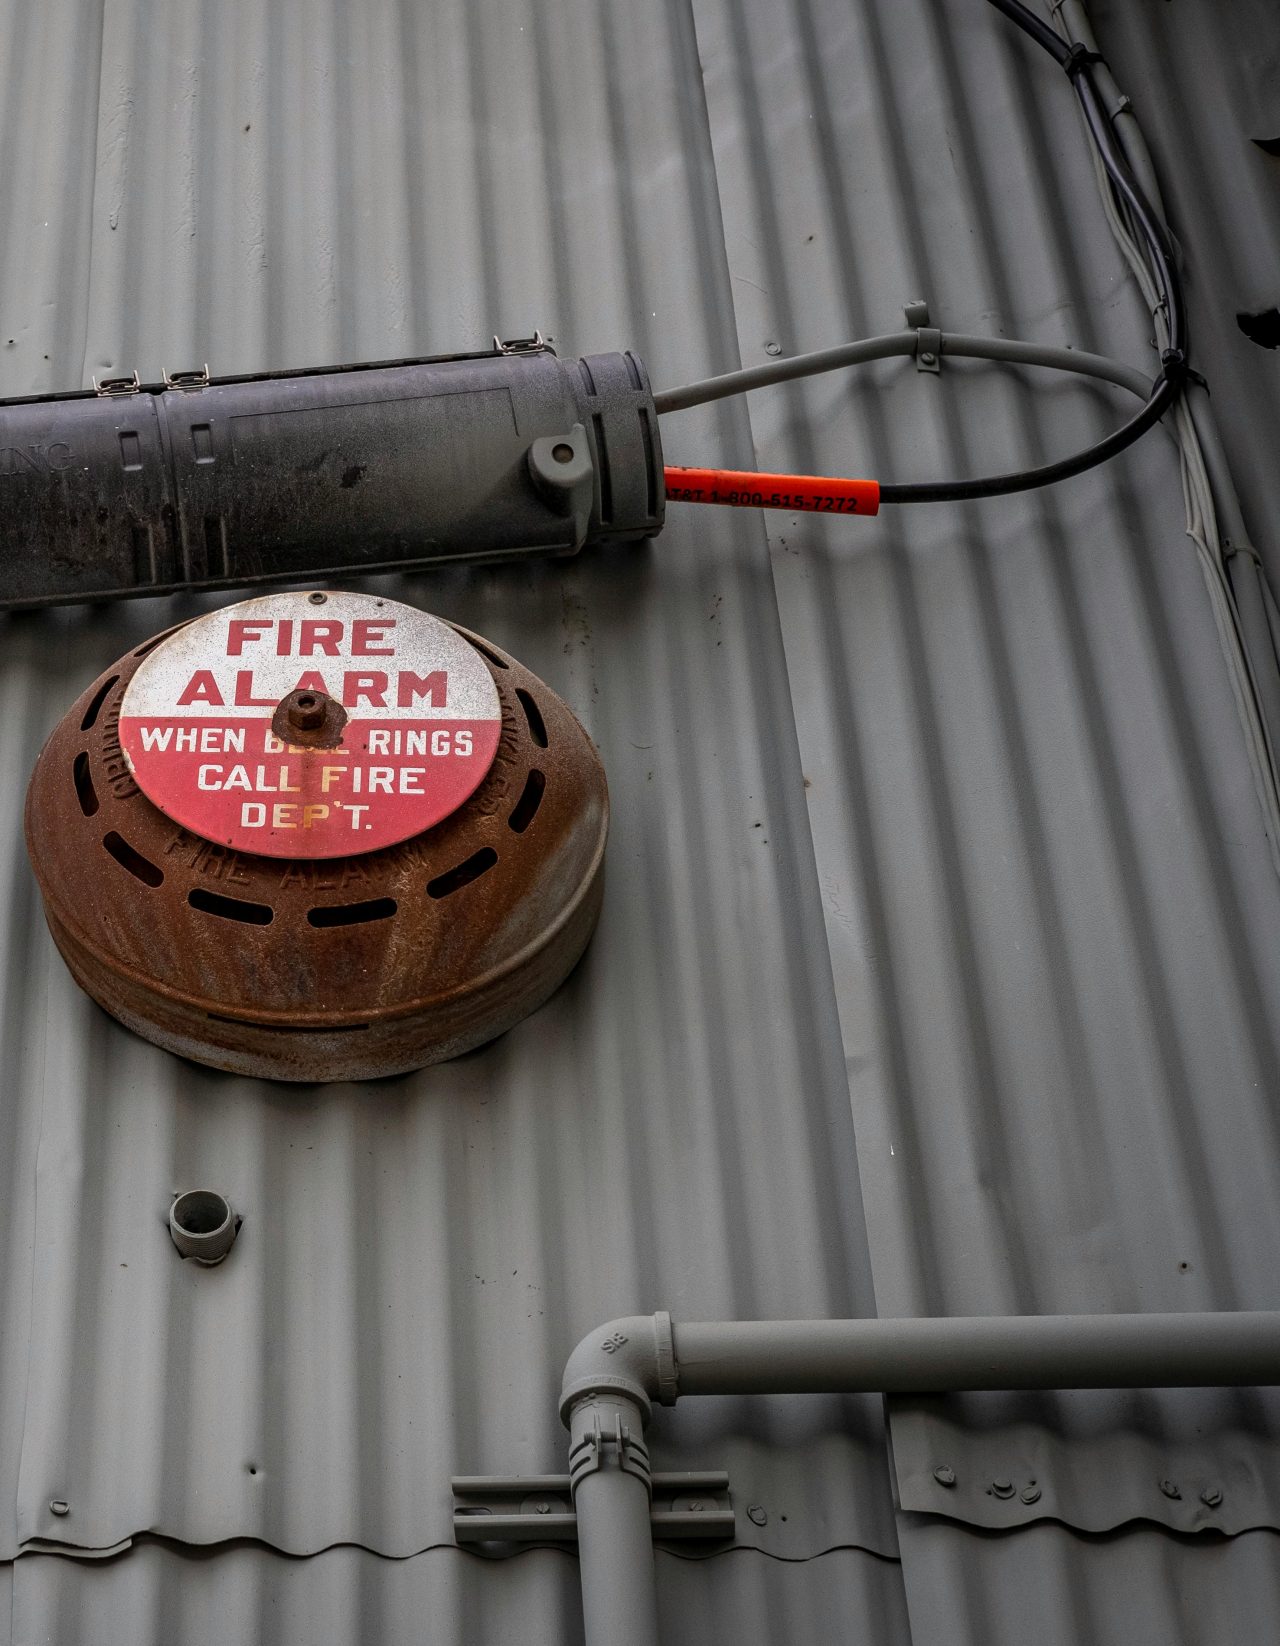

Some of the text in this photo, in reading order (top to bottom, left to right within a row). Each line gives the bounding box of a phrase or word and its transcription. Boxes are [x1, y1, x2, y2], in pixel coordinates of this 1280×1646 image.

[226, 619, 397, 656] FIRE
[140, 728, 246, 753] WHEN
[368, 729, 474, 757] RINGS
[197, 764, 426, 795] CALL FIRE
[241, 800, 372, 831] DEP'T.
